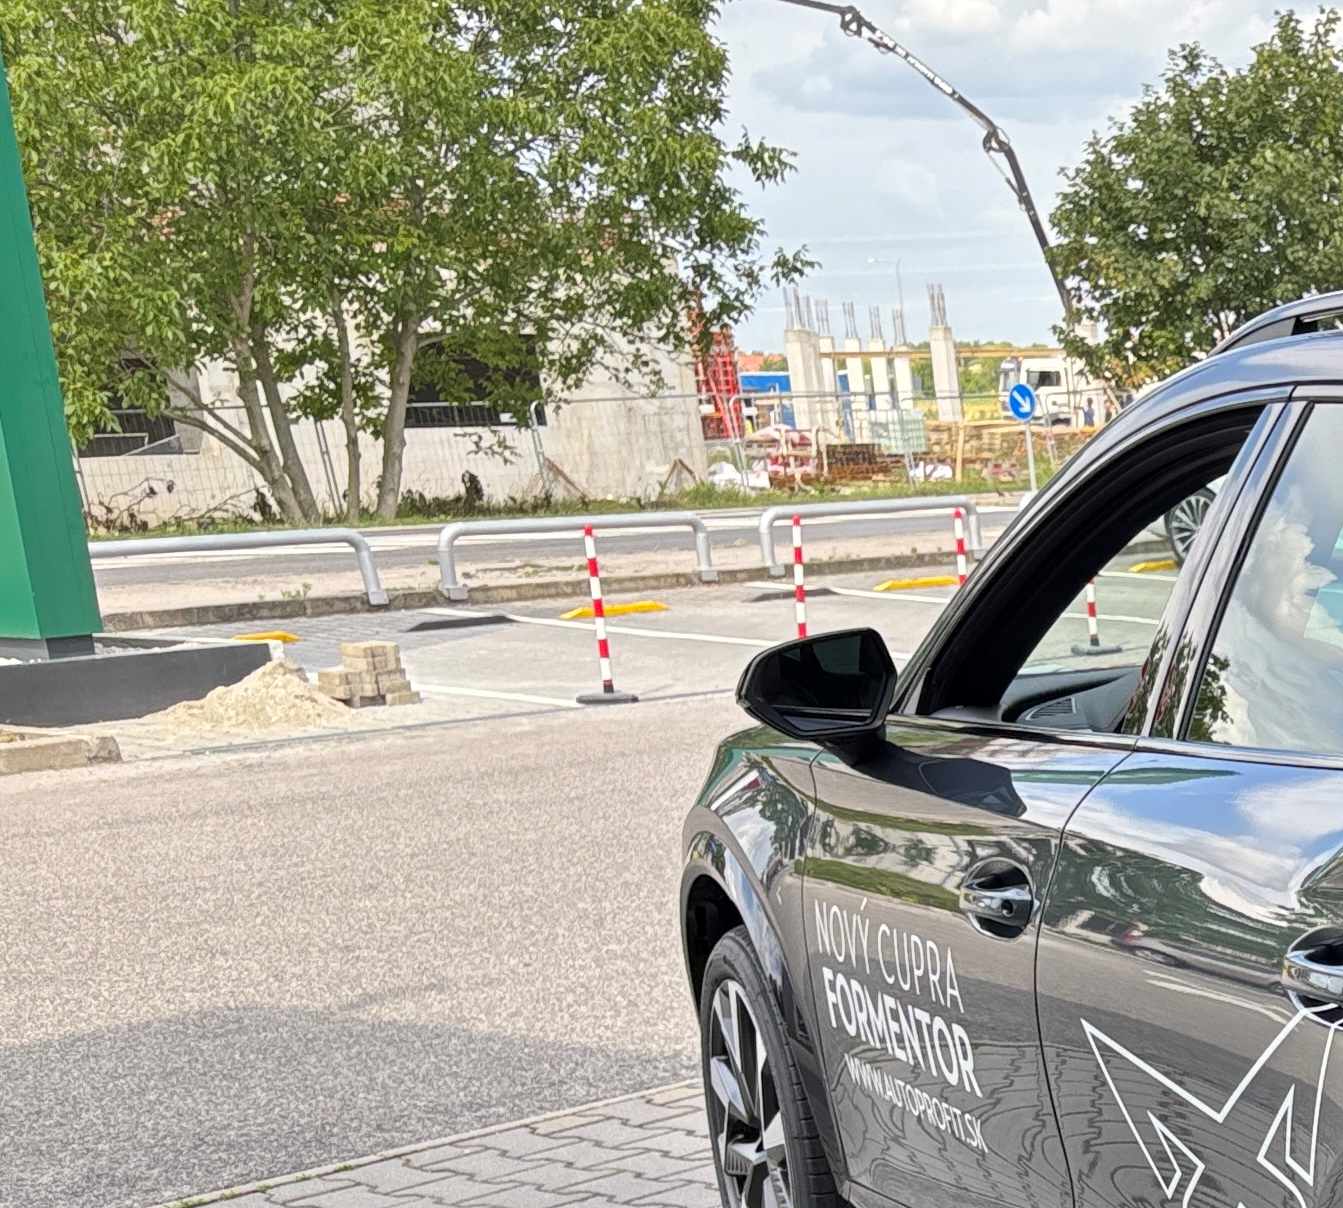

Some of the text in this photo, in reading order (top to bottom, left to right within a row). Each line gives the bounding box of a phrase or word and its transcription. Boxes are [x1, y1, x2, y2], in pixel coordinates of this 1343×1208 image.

[815, 897, 965, 1014] NOVÝ CUPRA
[822, 966, 984, 1098] FORMENTOR
[844, 1052, 989, 1153] WWW.AUTOPROFIT.SK
